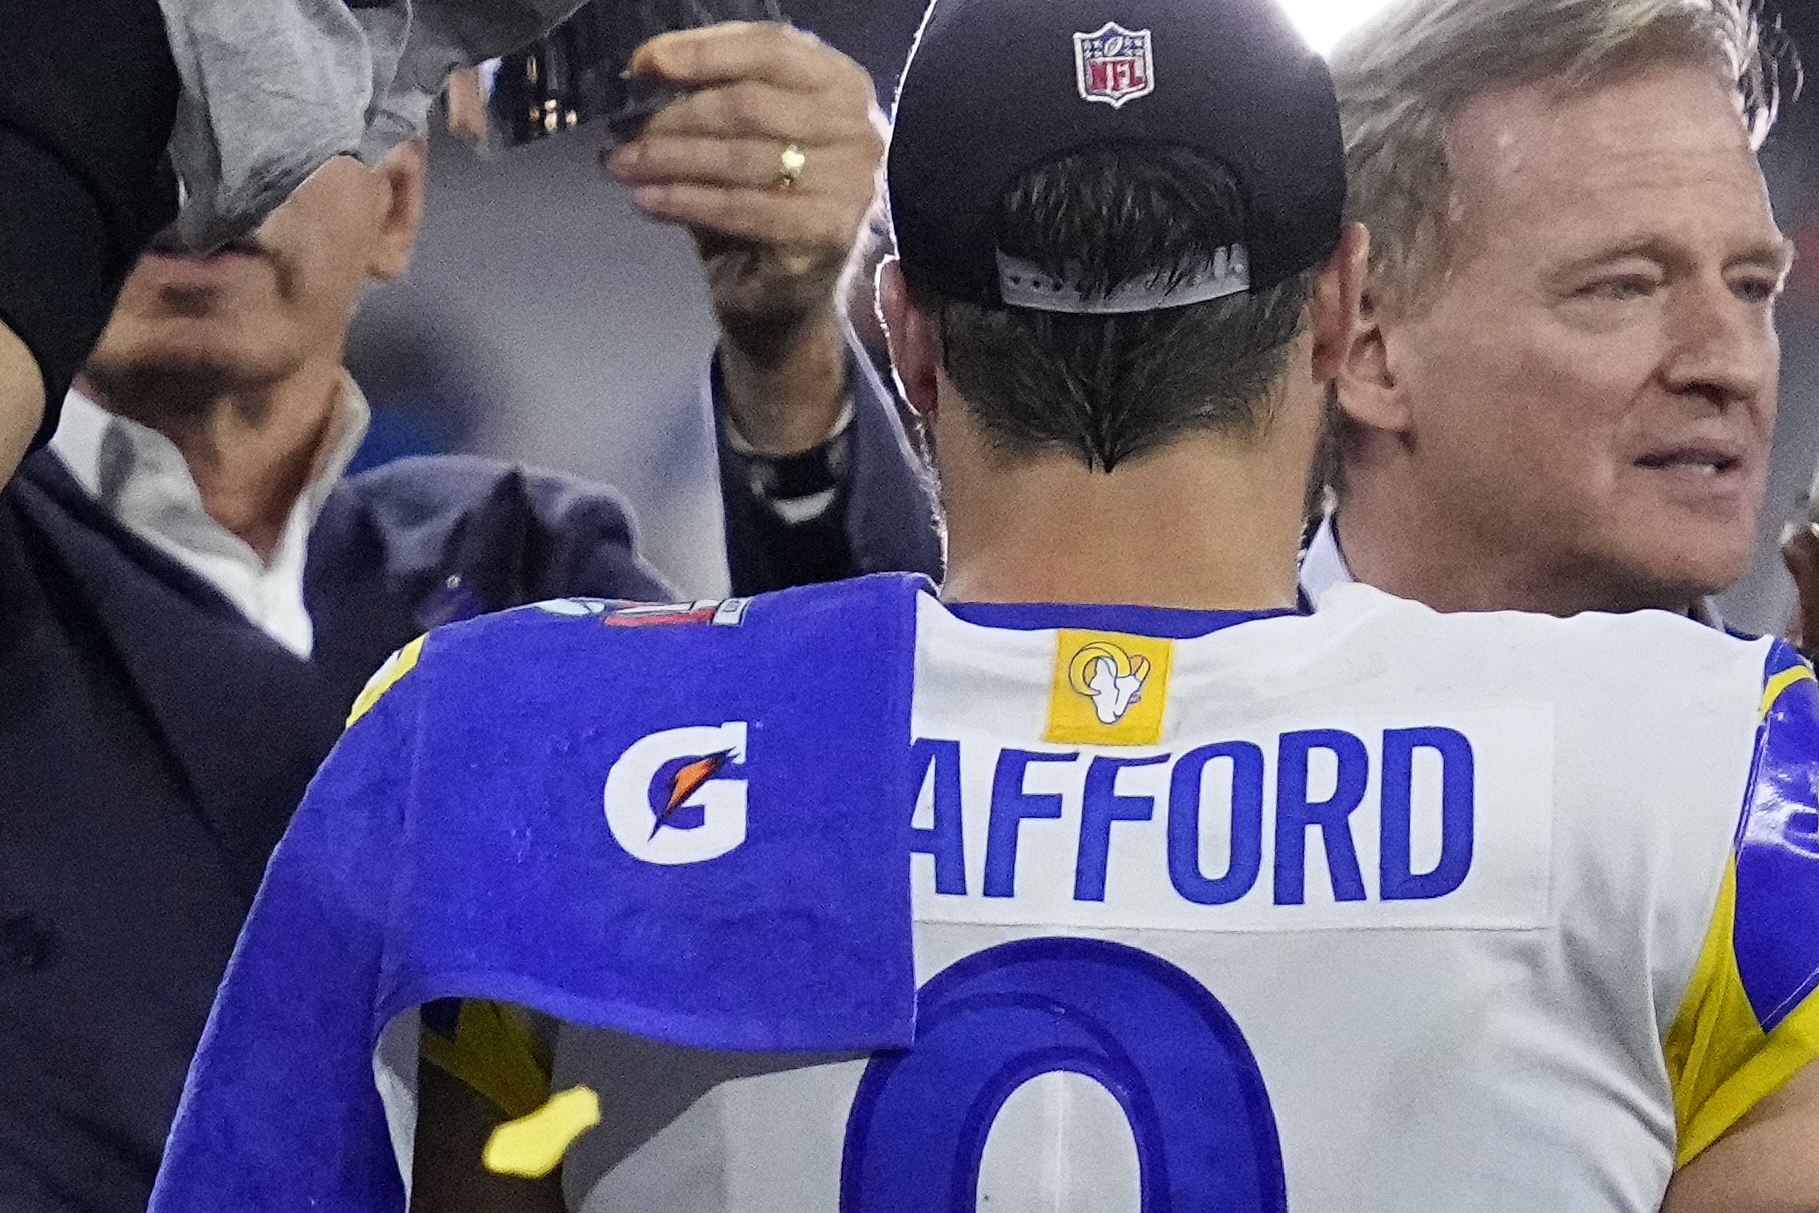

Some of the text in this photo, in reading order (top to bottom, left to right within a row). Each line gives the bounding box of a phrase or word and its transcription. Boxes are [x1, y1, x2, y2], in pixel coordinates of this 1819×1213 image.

[1087, 58, 1143, 91] NFL
[604, 720, 748, 865] G
[910, 726, 1474, 906] AFFORD
